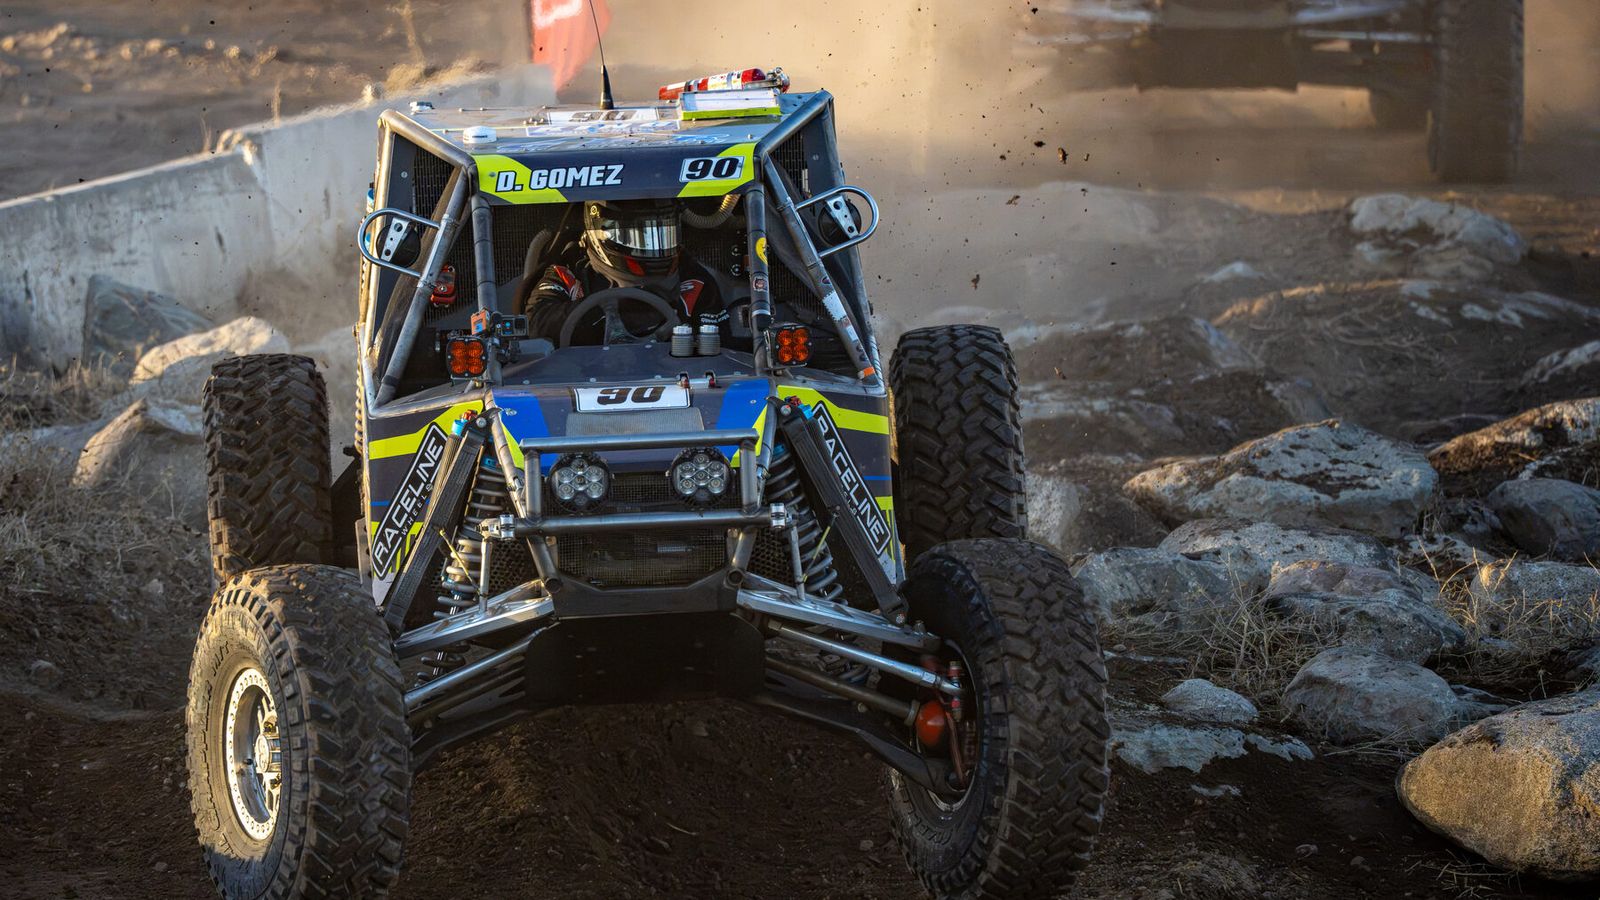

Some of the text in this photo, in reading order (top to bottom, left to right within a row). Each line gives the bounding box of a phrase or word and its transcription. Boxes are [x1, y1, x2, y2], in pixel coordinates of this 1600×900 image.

[496, 164, 624, 192] D. GOMEZ
[686, 158, 739, 180] 90
[597, 386, 666, 406] 90
[374, 437, 443, 565] RACELINE
